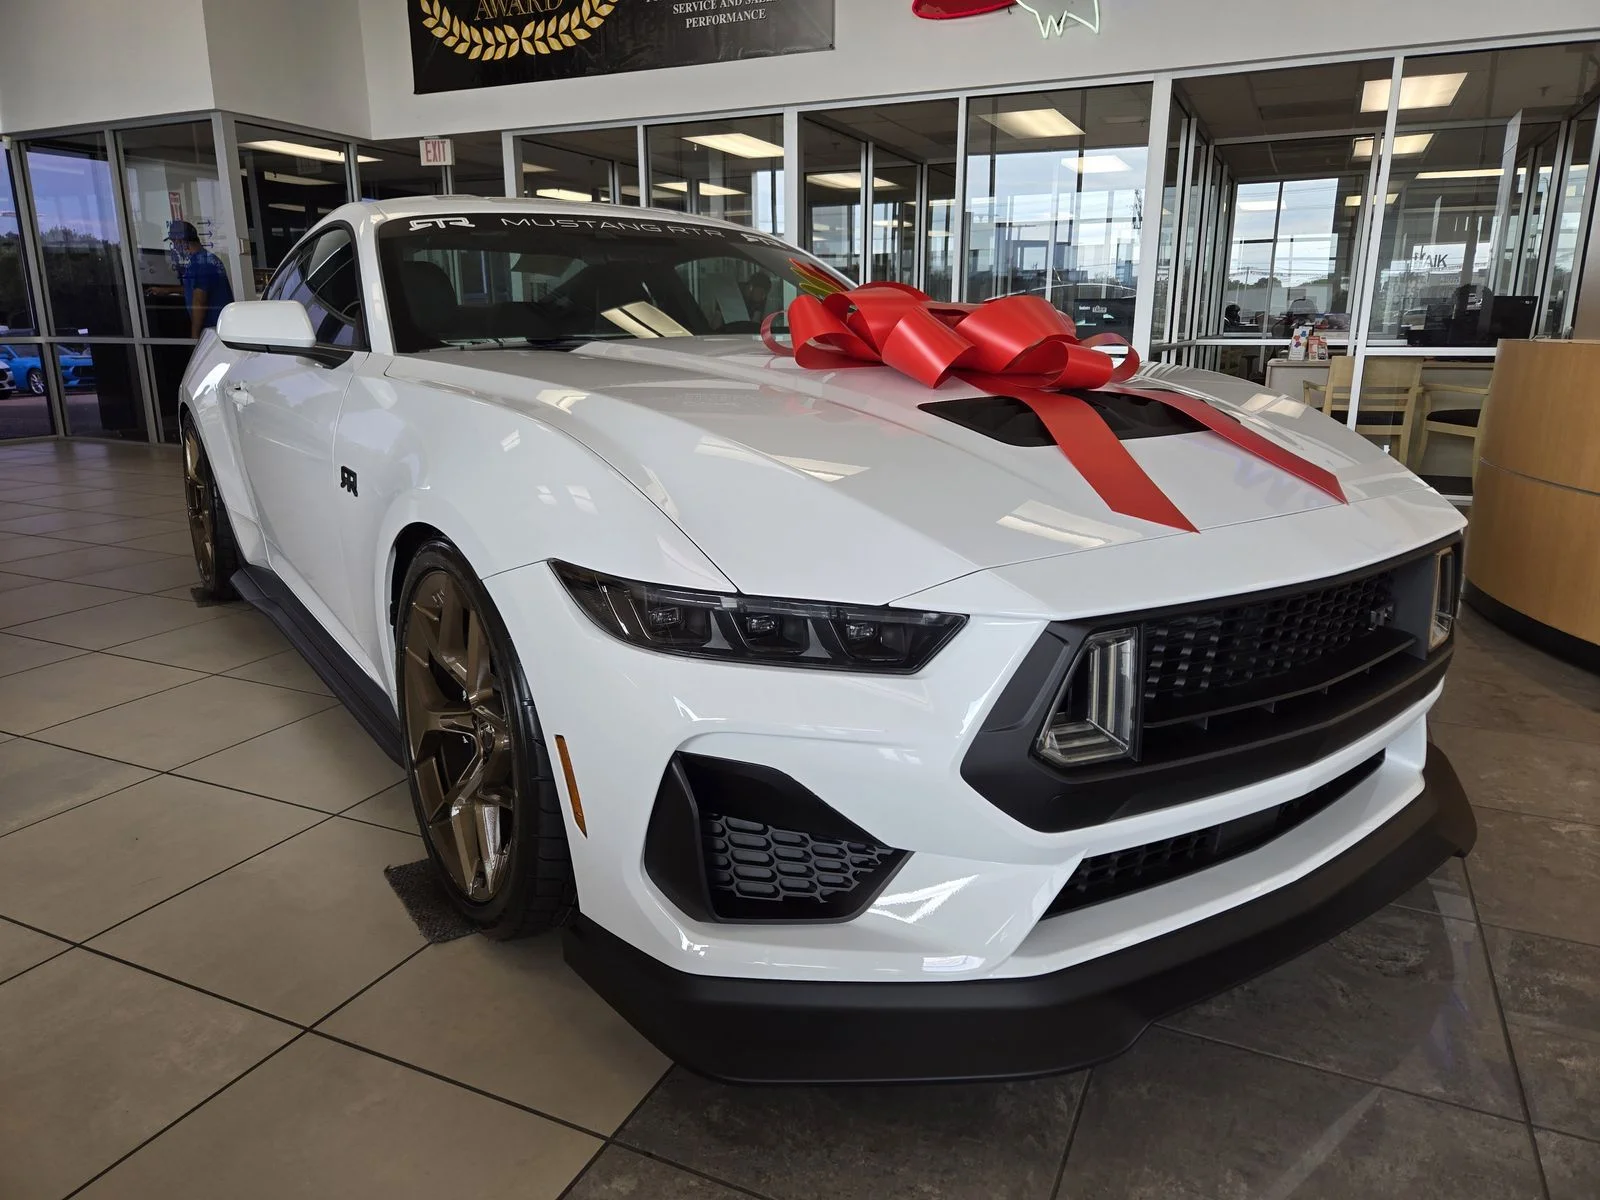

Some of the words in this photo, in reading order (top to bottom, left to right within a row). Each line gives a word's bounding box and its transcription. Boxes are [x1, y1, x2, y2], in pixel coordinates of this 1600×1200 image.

[672, 0, 717, 14] SERVICE
[720, 0, 743, 8] AND
[685, 8, 767, 29] PERFORMANCE
[424, 140, 447, 163] EXIT
[500, 218, 662, 232] MUSTANG
[667, 225, 726, 239] RTR
